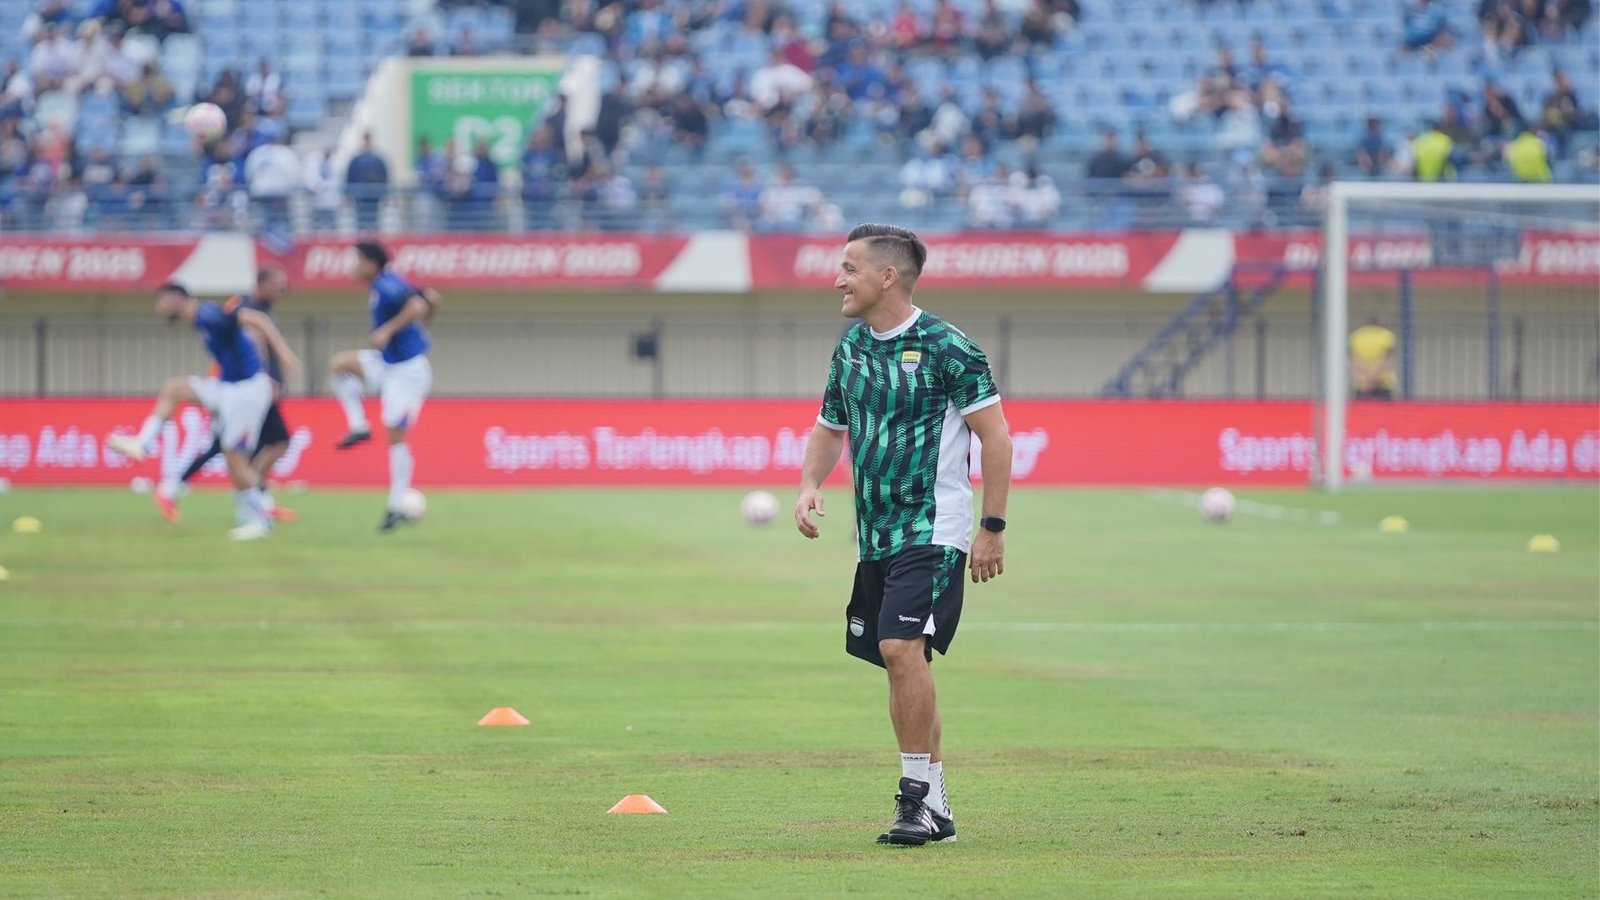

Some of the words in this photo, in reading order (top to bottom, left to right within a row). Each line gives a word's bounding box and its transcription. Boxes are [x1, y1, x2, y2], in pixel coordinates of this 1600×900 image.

[484, 426, 590, 472] Sports
[592, 426, 771, 475] Terlengkap
[1507, 428, 1568, 472] Ada
